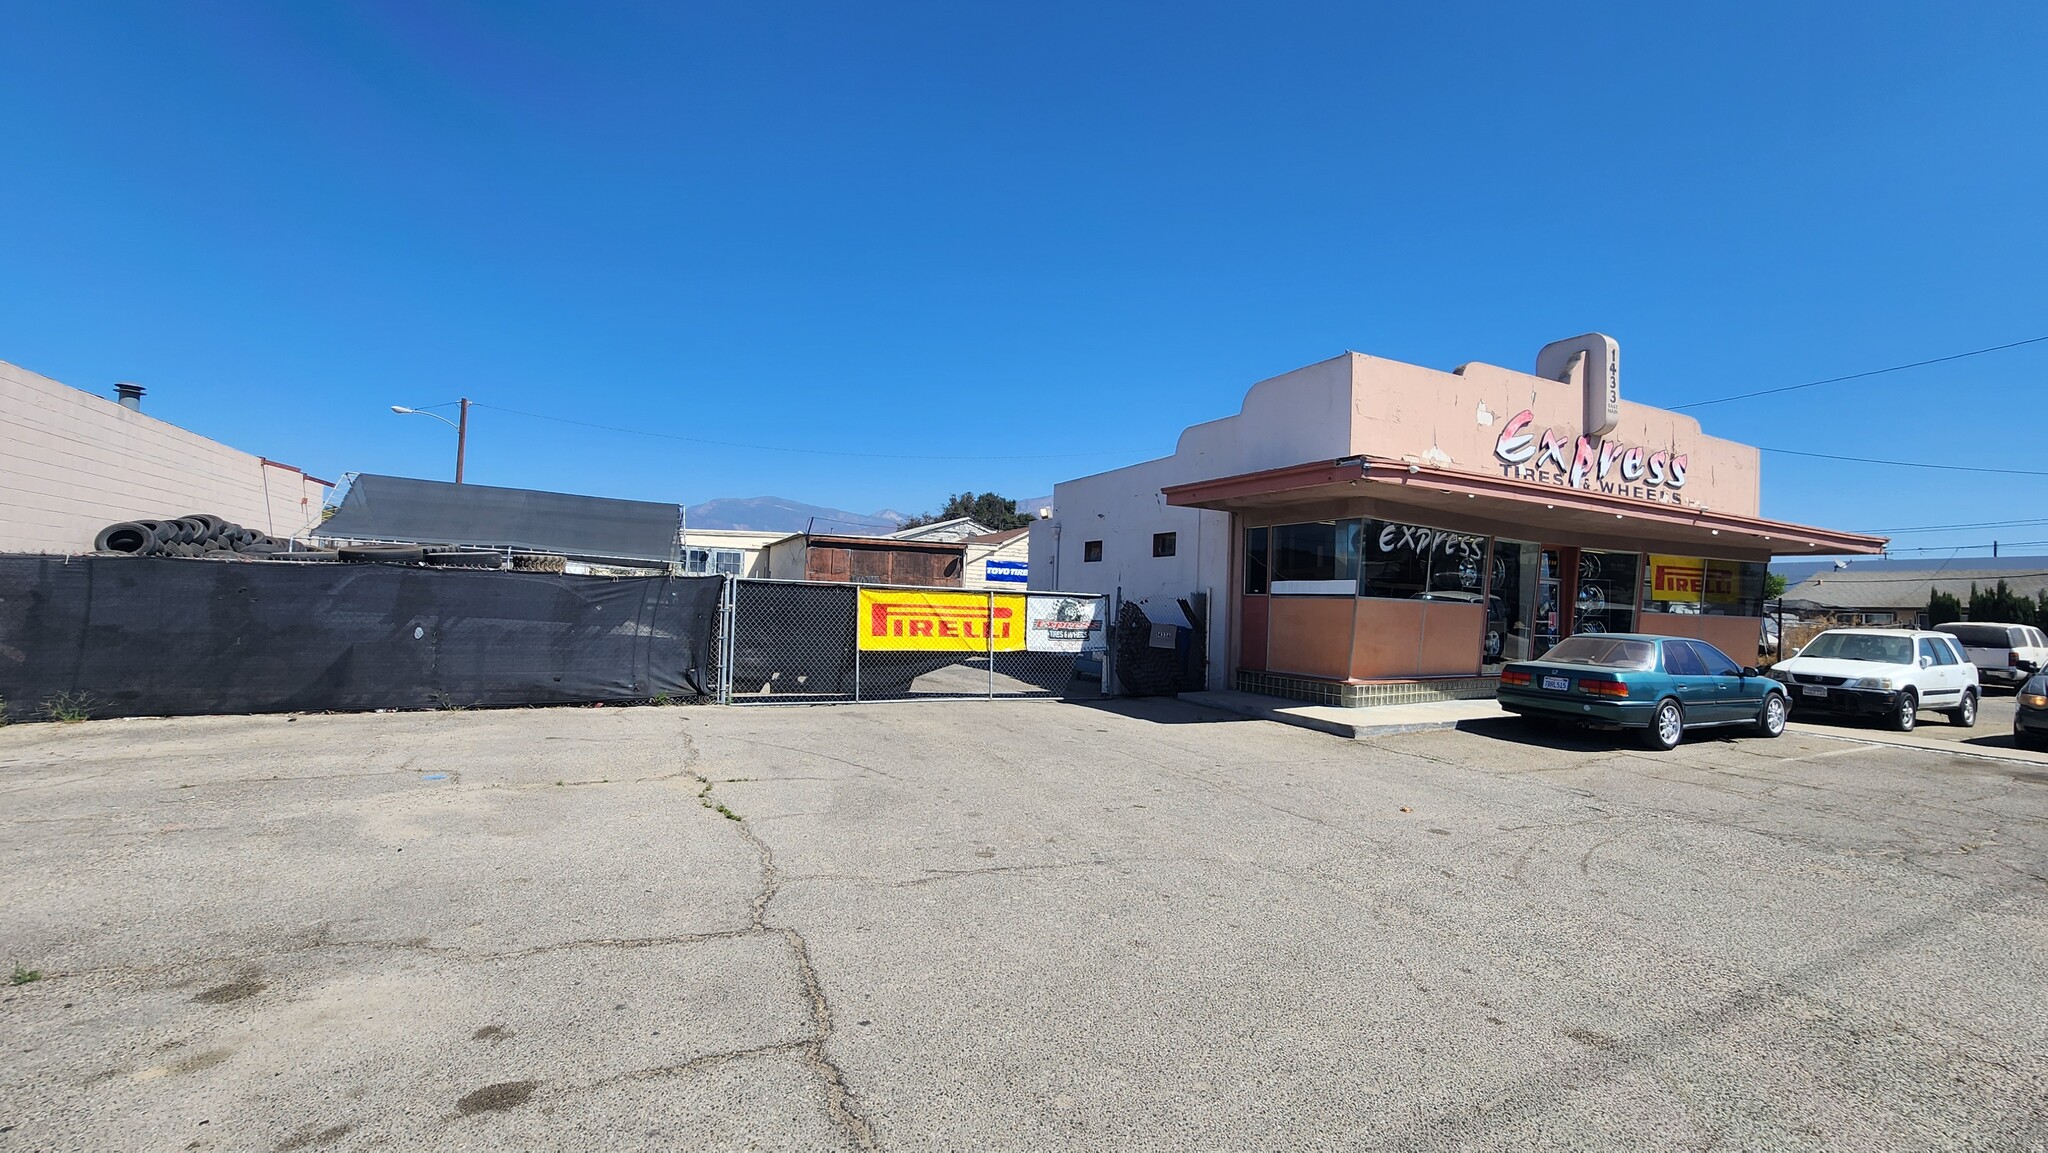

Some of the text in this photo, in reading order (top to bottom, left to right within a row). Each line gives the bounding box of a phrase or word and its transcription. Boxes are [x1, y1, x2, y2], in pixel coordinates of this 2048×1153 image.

[1609, 349, 1617, 403] 1433
[1494, 409, 1688, 489] Express
[1499, 463, 1563, 485] TIRES
[986, 567, 1010, 575] TOYO
[1655, 565, 1732, 594] PIRELLI
[871, 603, 1013, 638] PIRELLI
